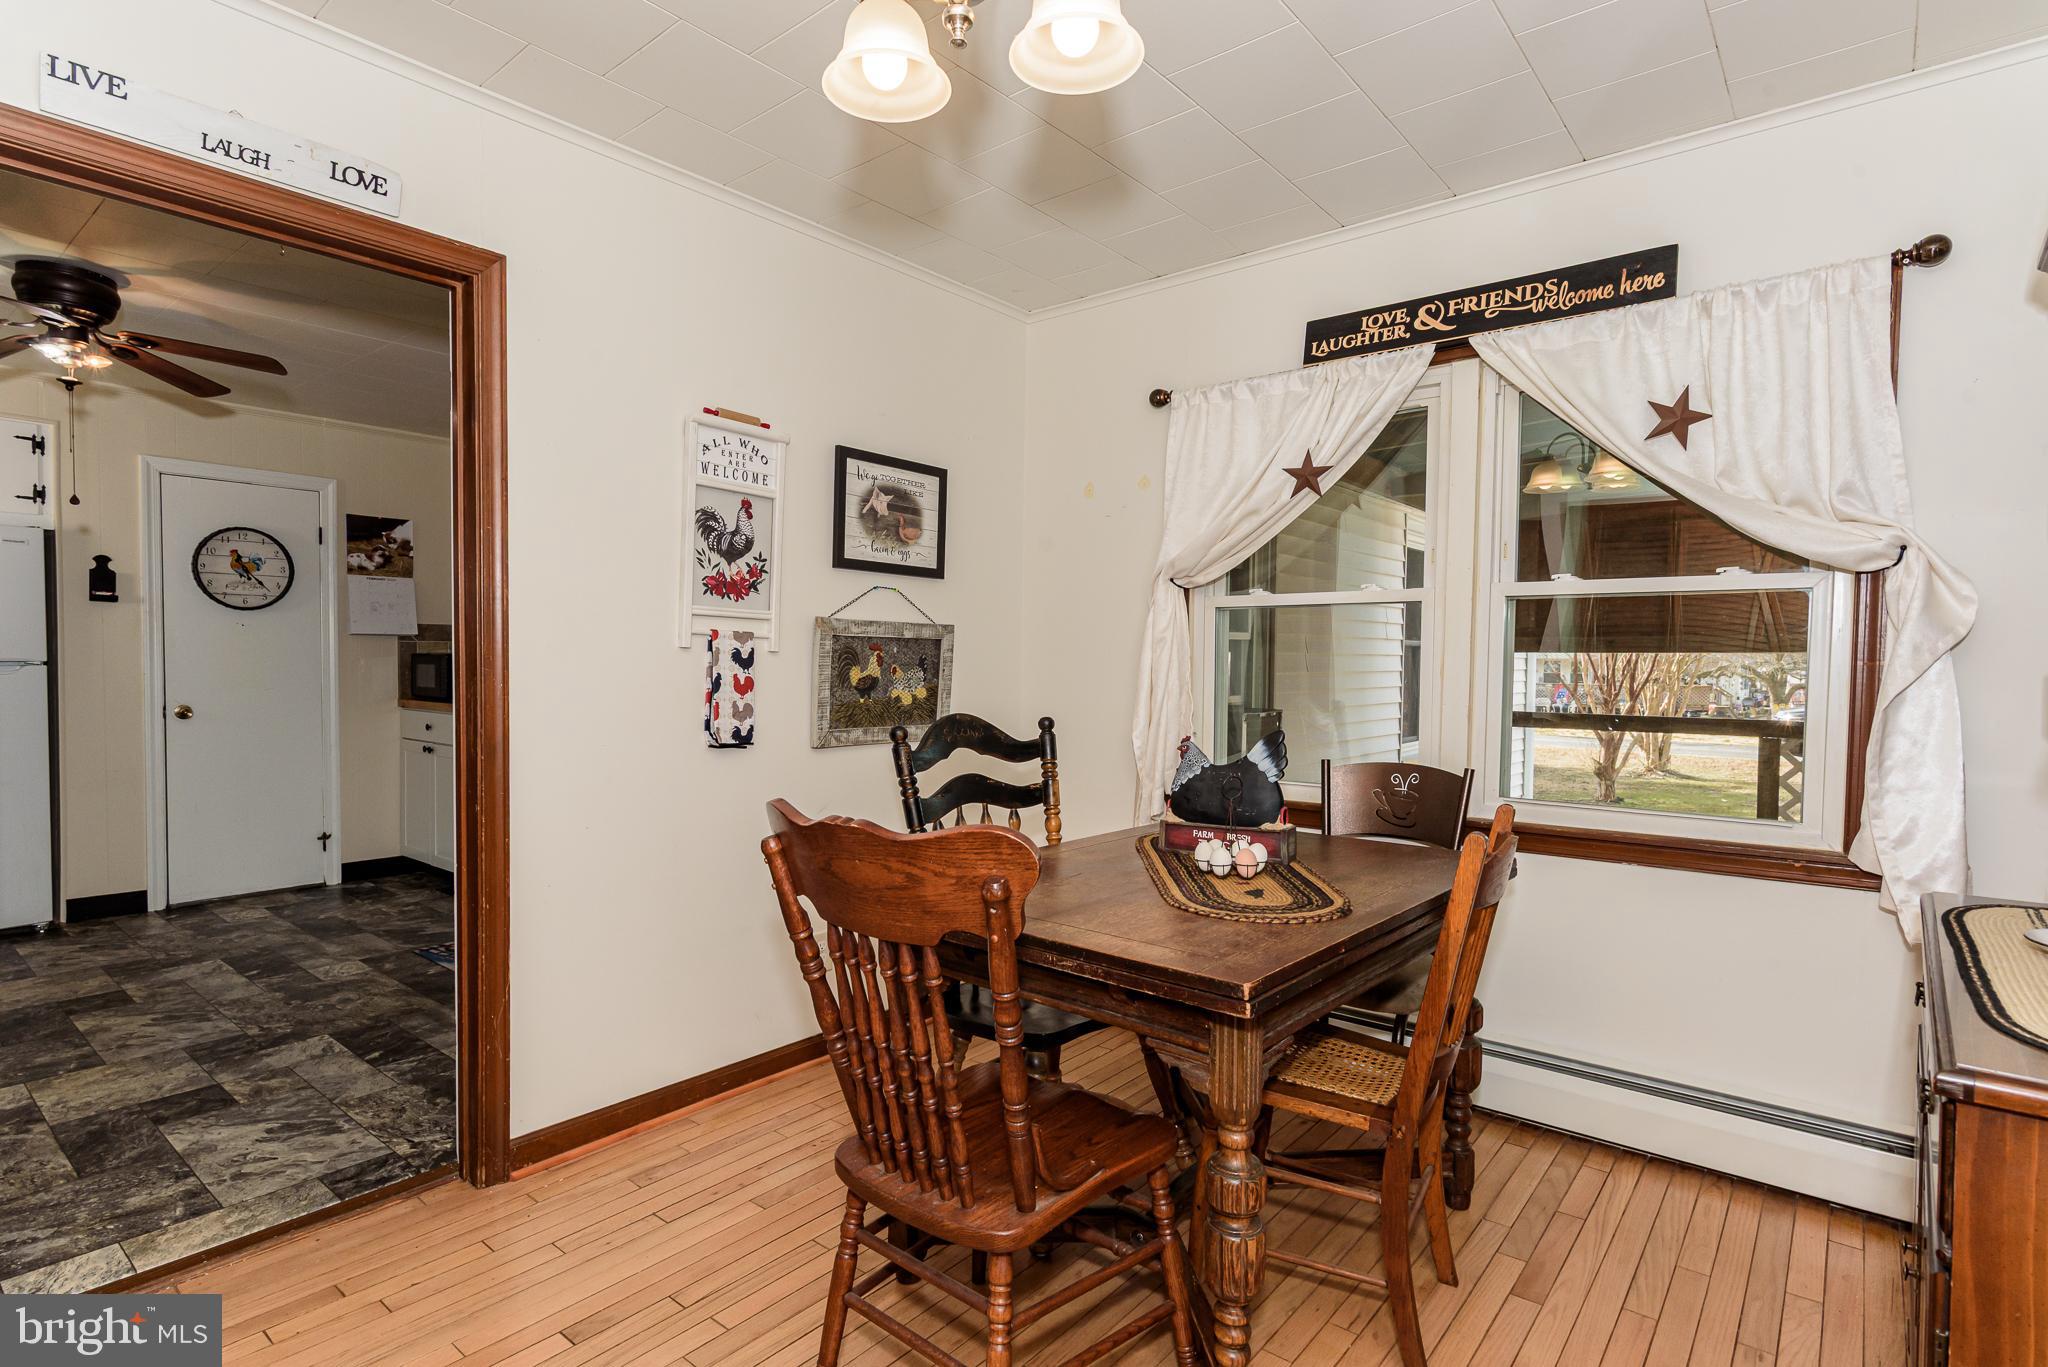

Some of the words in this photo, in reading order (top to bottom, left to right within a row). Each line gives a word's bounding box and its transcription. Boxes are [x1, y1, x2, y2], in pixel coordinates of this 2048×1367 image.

[47, 54, 128, 100] LIVE
[200, 132, 271, 170] LAUGH
[329, 161, 388, 196] LOVE
[1446, 278, 1558, 318] FRIENDS
[1485, 281, 1613, 318] welcome
[1619, 268, 1665, 296] here
[1361, 308, 1411, 331] LOVE,
[1414, 300, 1457, 331] &
[1311, 325, 1411, 356] LAUGHTER,
[702, 436, 730, 456] ALL
[739, 437, 769, 465] WHO
[721, 449, 754, 462] ENTER
[728, 459, 747, 469] ARE
[701, 461, 769, 486] WELCOME
[880, 474, 926, 489] TOGETHER
[904, 488, 924, 498] LIKE
[238, 532, 248, 540] 12
[206, 547, 216, 555] 10
[898, 550, 911, 562] eggs
[280, 566, 286, 574] 3
[207, 579, 213, 587] 8
[243, 597, 248, 605] 6
[1193, 829, 1214, 839] FARM
